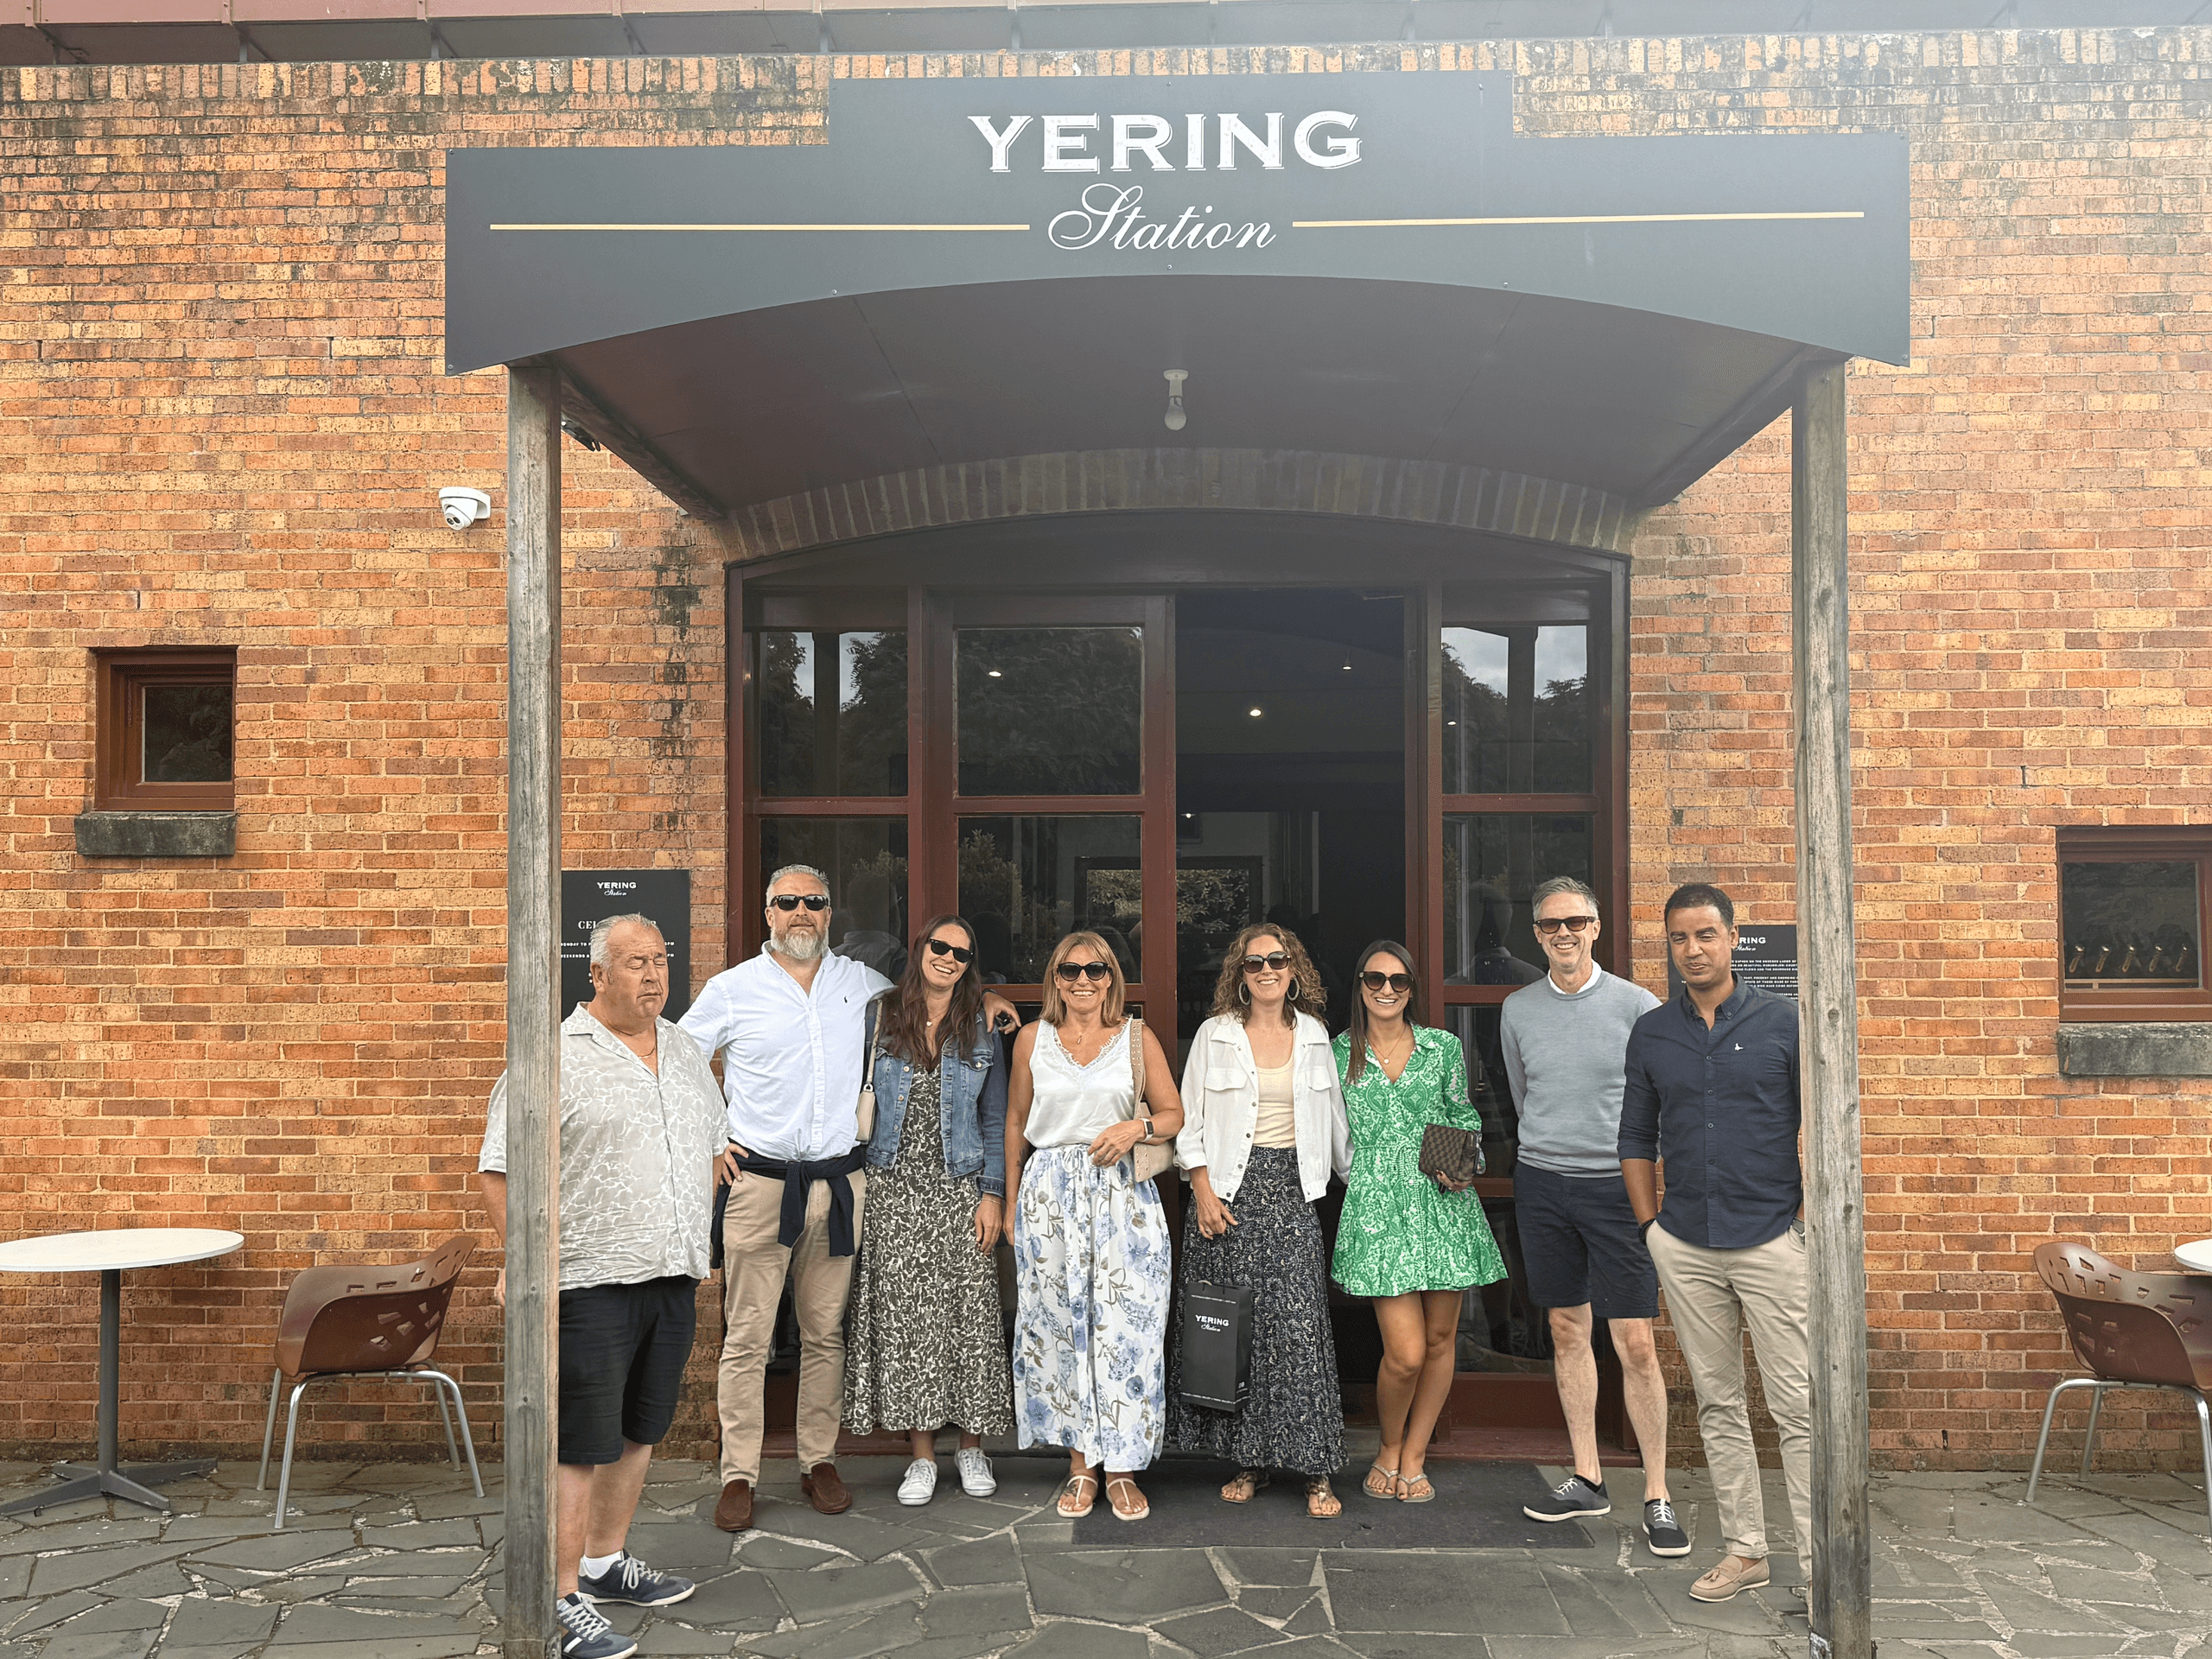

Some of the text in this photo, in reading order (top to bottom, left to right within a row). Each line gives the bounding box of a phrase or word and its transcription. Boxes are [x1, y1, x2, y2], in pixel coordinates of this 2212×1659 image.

[967, 111, 1363, 175] YERING
[1048, 183, 1276, 250] Station
[1195, 1314, 1230, 1326] YERING
